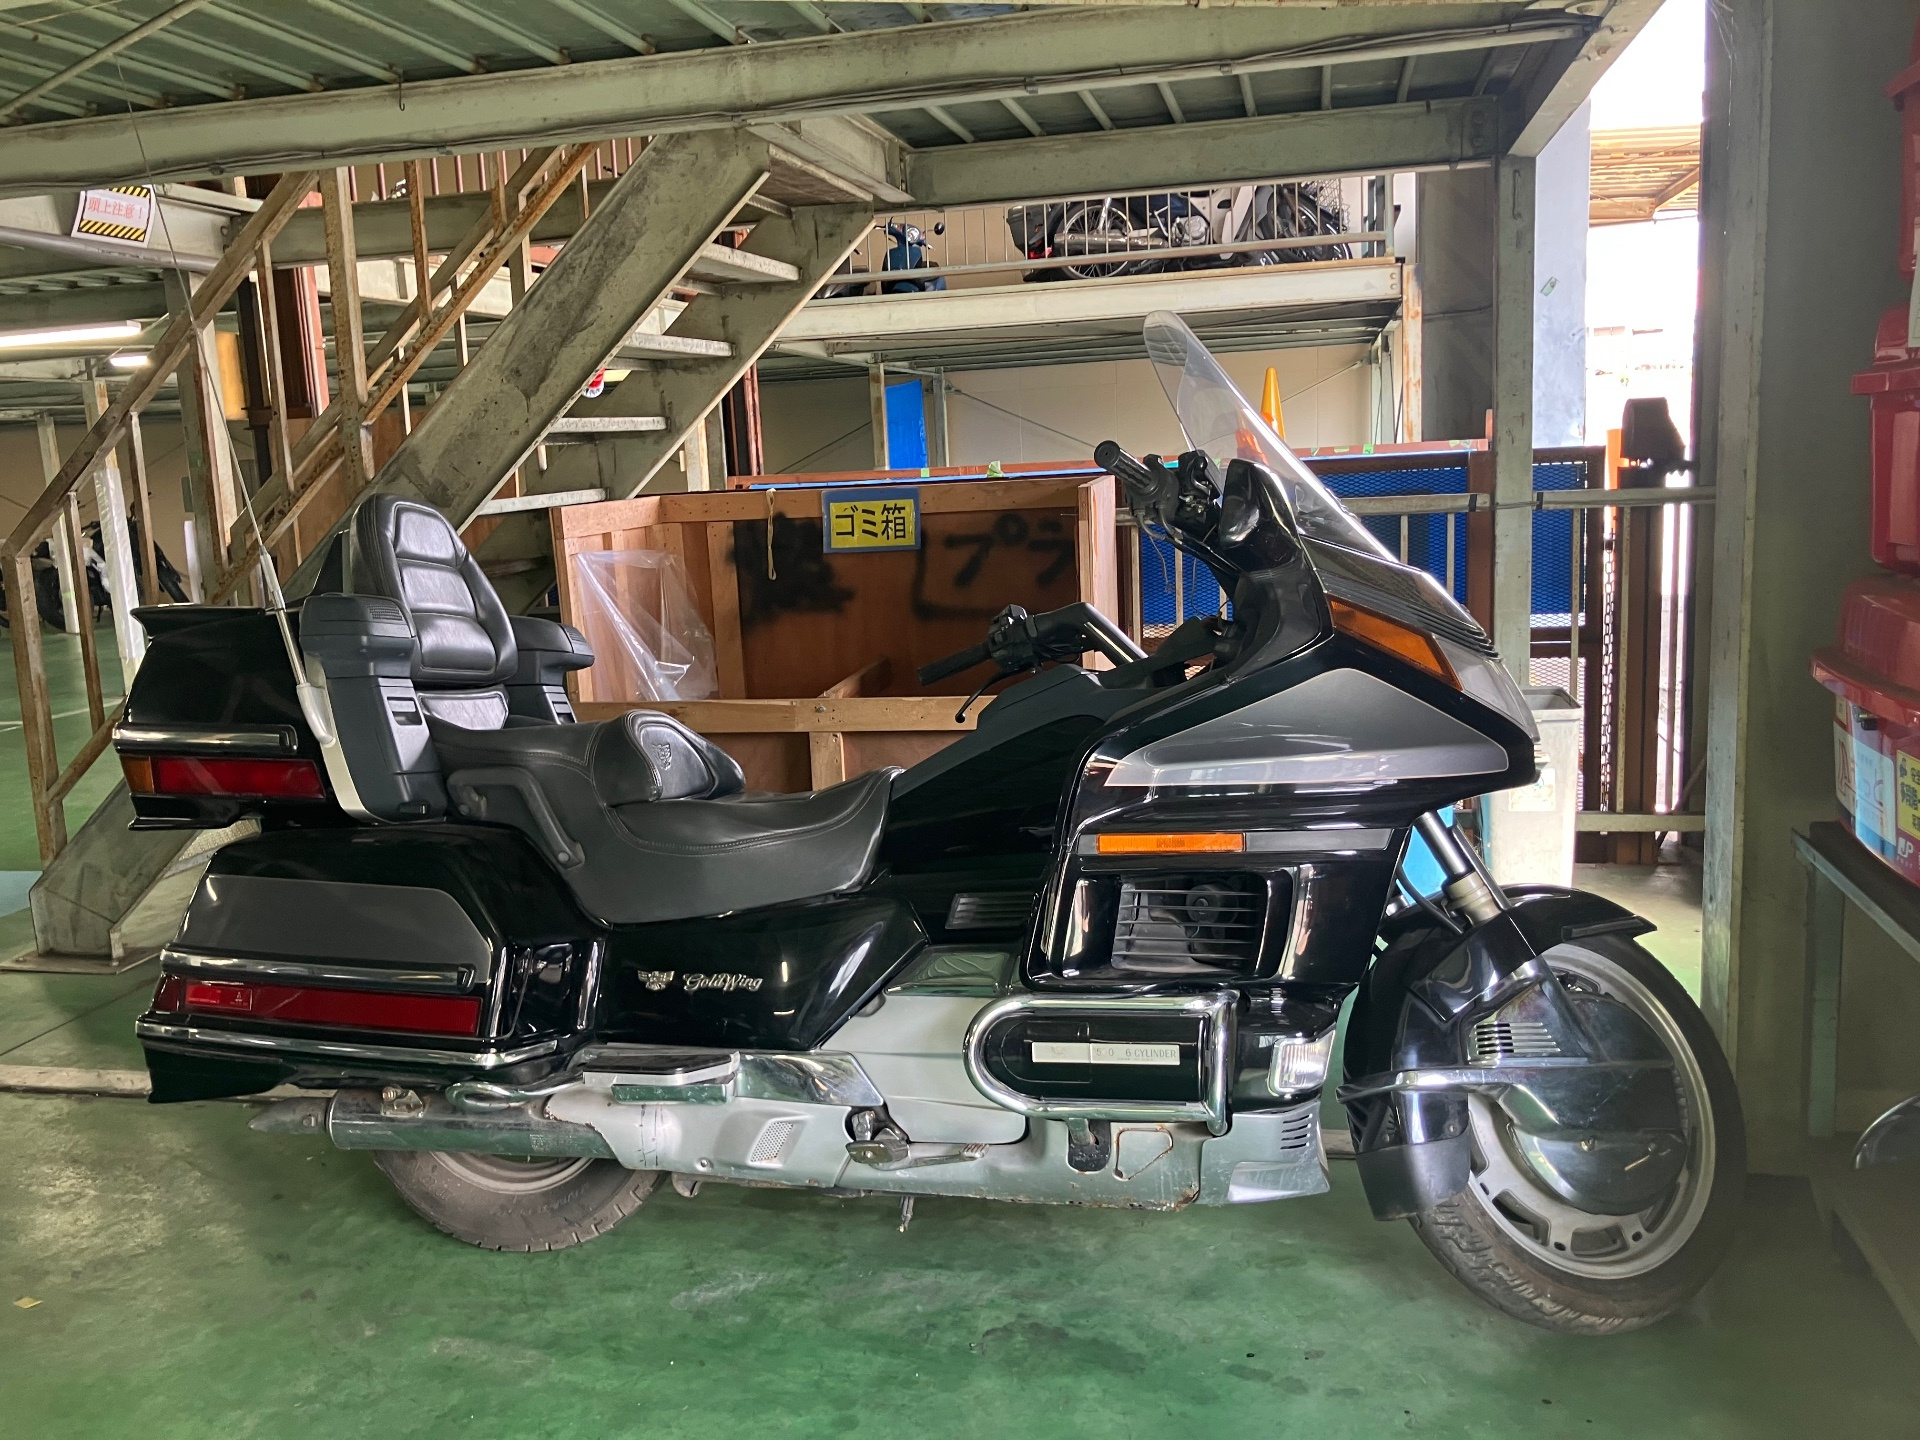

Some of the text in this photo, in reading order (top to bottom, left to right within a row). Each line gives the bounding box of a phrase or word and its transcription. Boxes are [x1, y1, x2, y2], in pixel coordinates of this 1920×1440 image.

[835, 503, 907, 541] ゴミ箱
[682, 973, 764, 992] GoldWing
[1125, 1048, 1132, 1057] 6
[1134, 1048, 1177, 1058] CYLINDER
